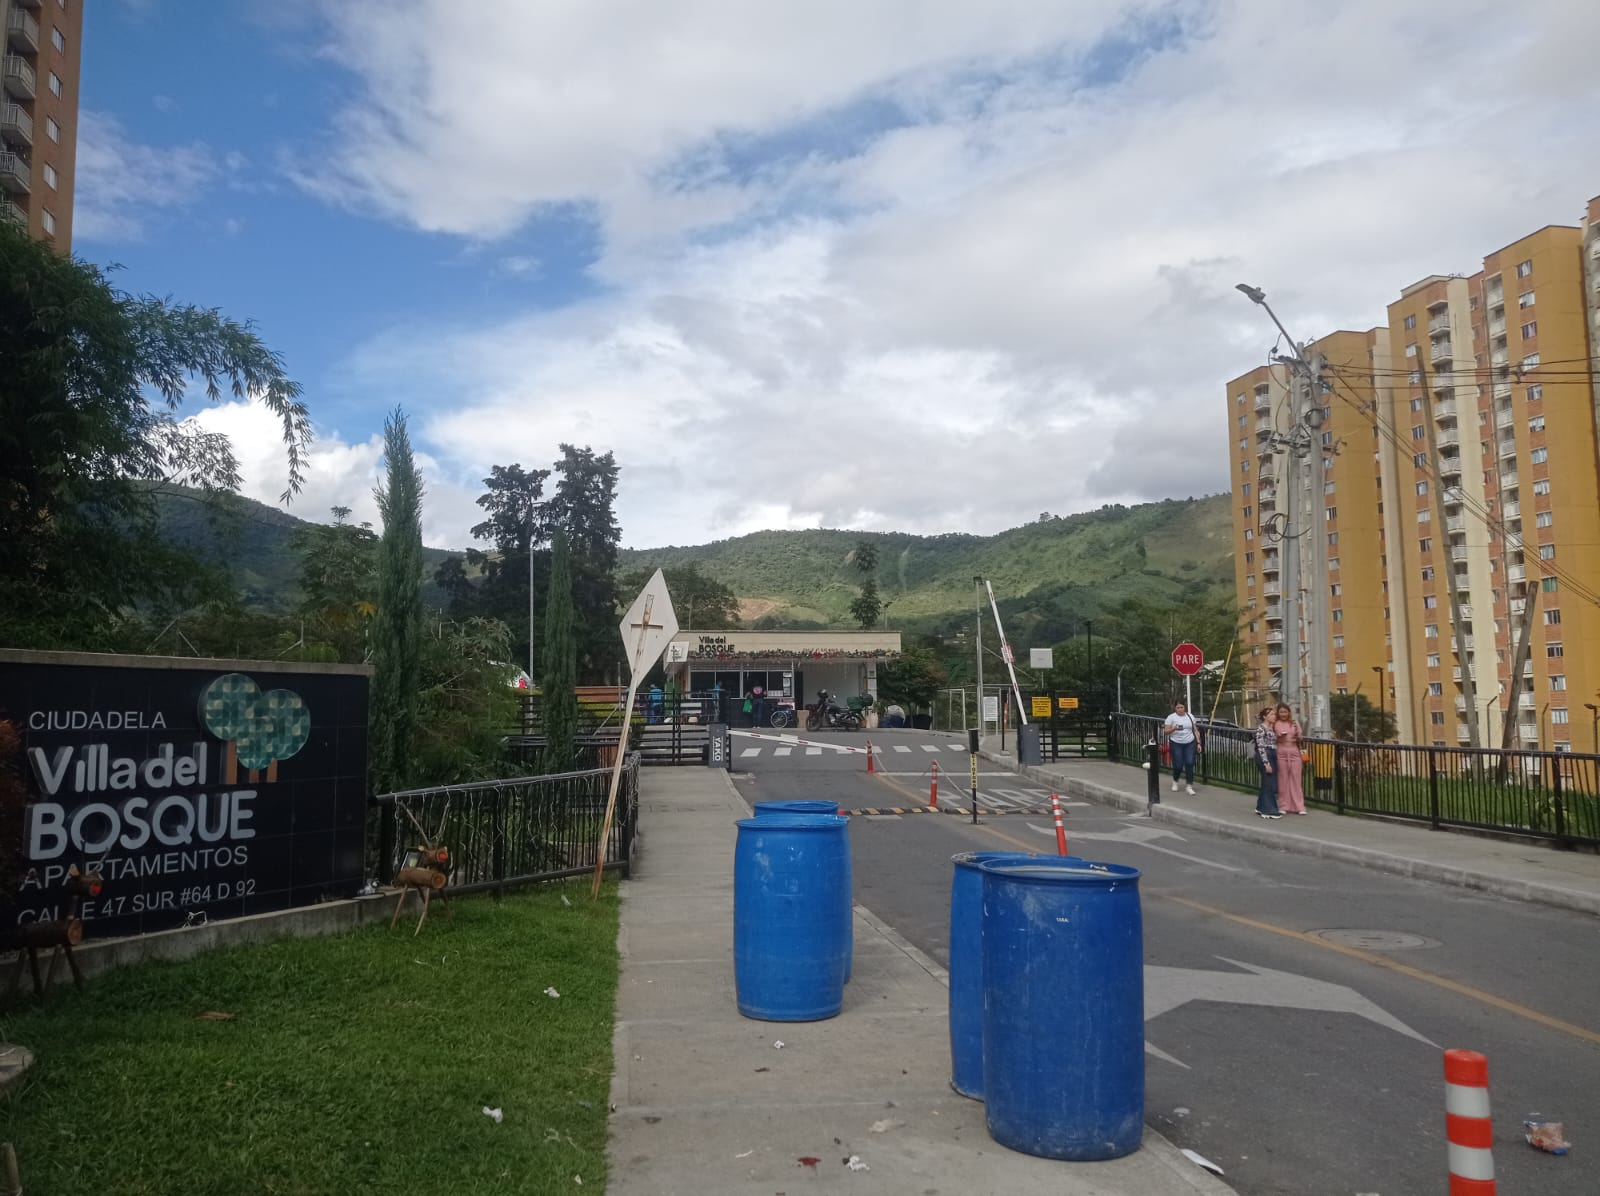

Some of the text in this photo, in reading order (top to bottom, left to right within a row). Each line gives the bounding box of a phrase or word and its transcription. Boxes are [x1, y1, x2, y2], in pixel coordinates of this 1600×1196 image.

[1175, 654, 1200, 665] PARE
[28, 711, 167, 731] CIUDADELA
[714, 736, 722, 761] YAKO
[28, 741, 208, 794] Villa del
[26, 790, 258, 860] BOSQUE
[17, 878, 257, 925] CALE 47 SUR #64 D 92
